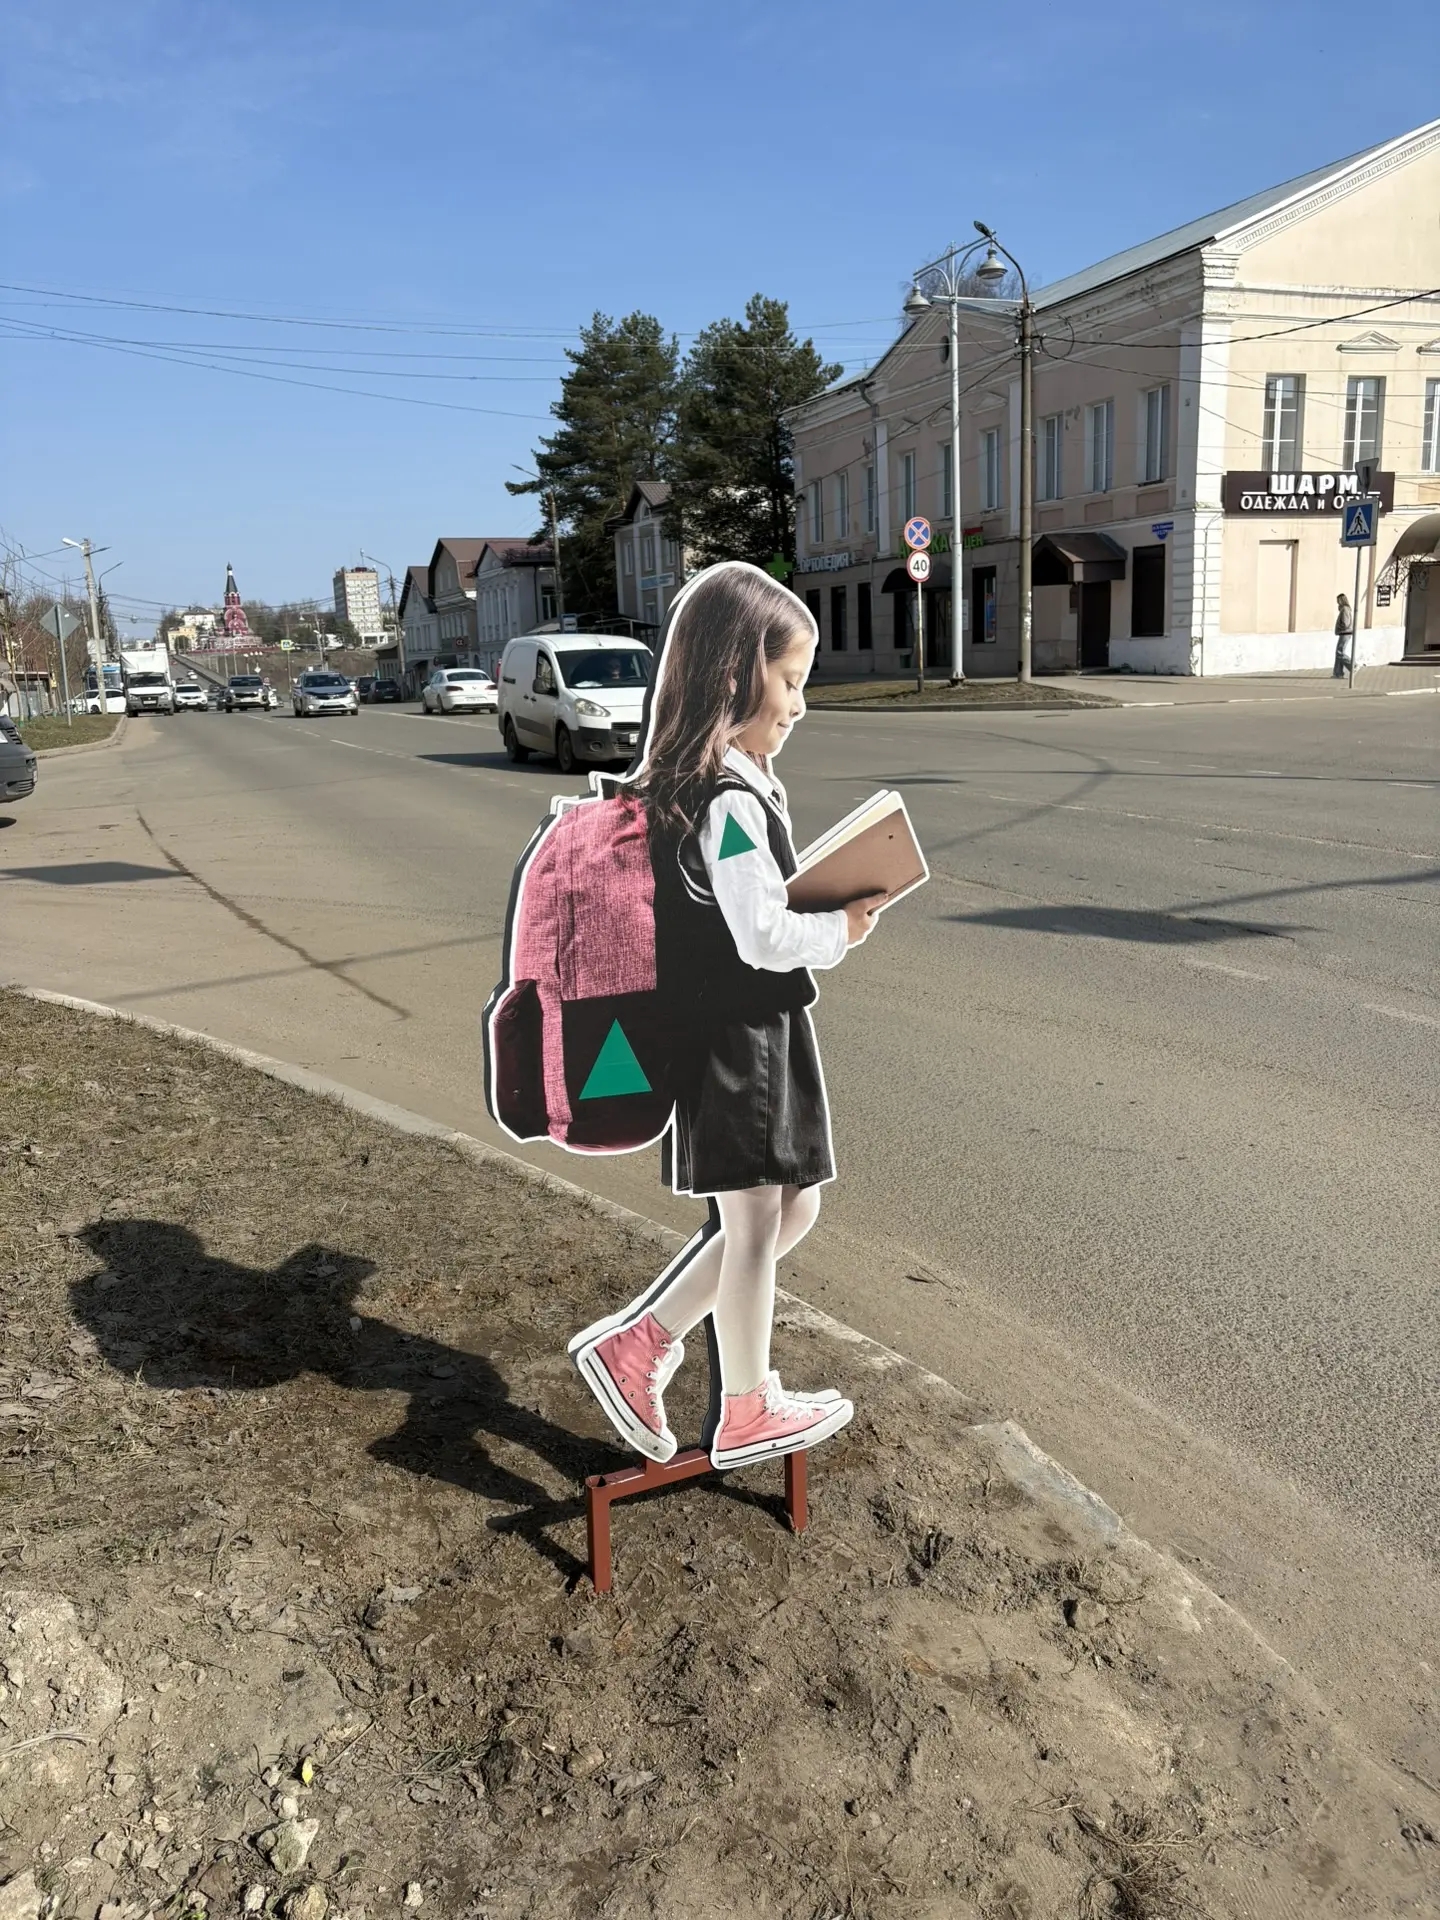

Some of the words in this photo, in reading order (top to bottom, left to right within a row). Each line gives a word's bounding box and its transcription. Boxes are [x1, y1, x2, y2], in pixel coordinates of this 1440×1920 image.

[1271, 474, 1358, 494] ШАРМ
[1240, 495, 1310, 510] ОДЕЖДА
[800, 552, 849, 573] ОРТОПЕДИЯ
[913, 560, 928, 573] 40
